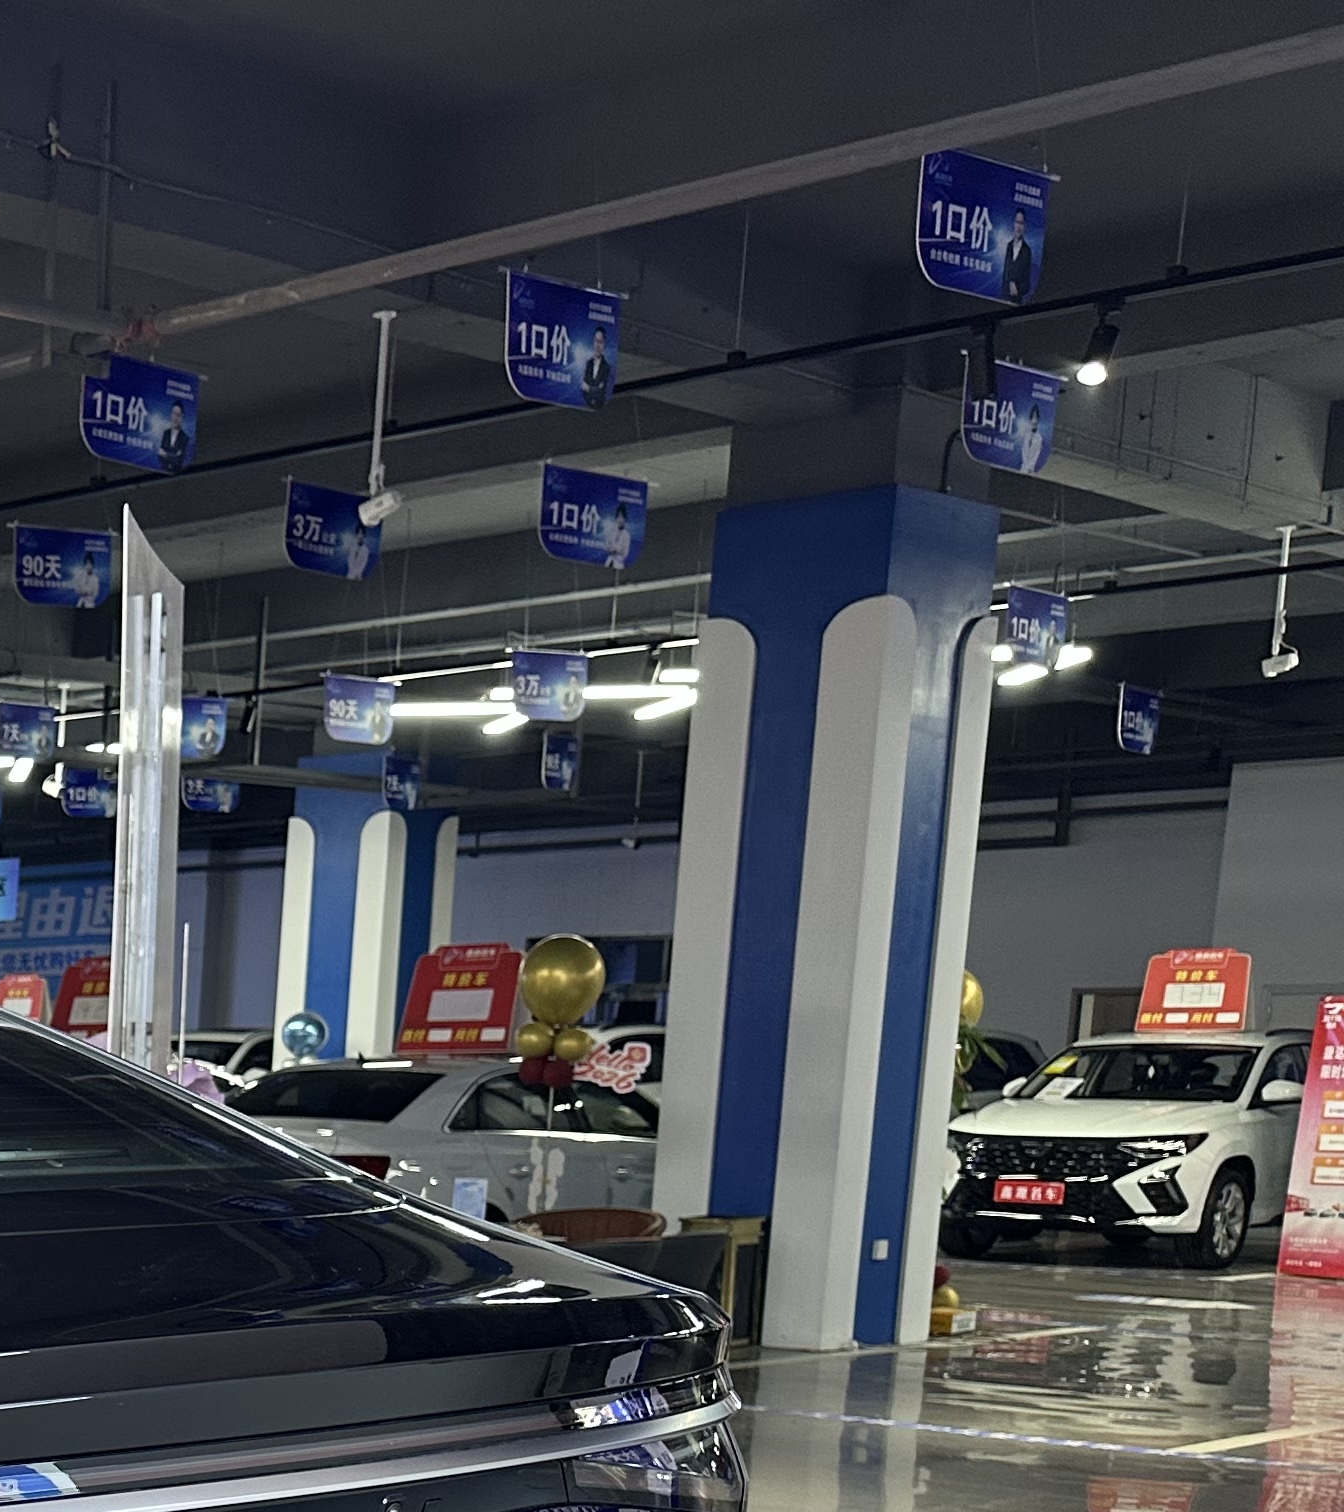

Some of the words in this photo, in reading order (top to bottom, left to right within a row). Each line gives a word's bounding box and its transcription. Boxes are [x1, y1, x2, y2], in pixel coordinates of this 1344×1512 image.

[931, 199, 993, 253] 1口价
[516, 320, 572, 367] 1口价
[92, 389, 149, 434] 1口价
[971, 399, 1017, 436] 1口价
[549, 500, 601, 537] 1口价
[21, 554, 62, 580] 90天
[1011, 615, 1042, 644] 1口价
[328, 698, 359, 721] 90天
